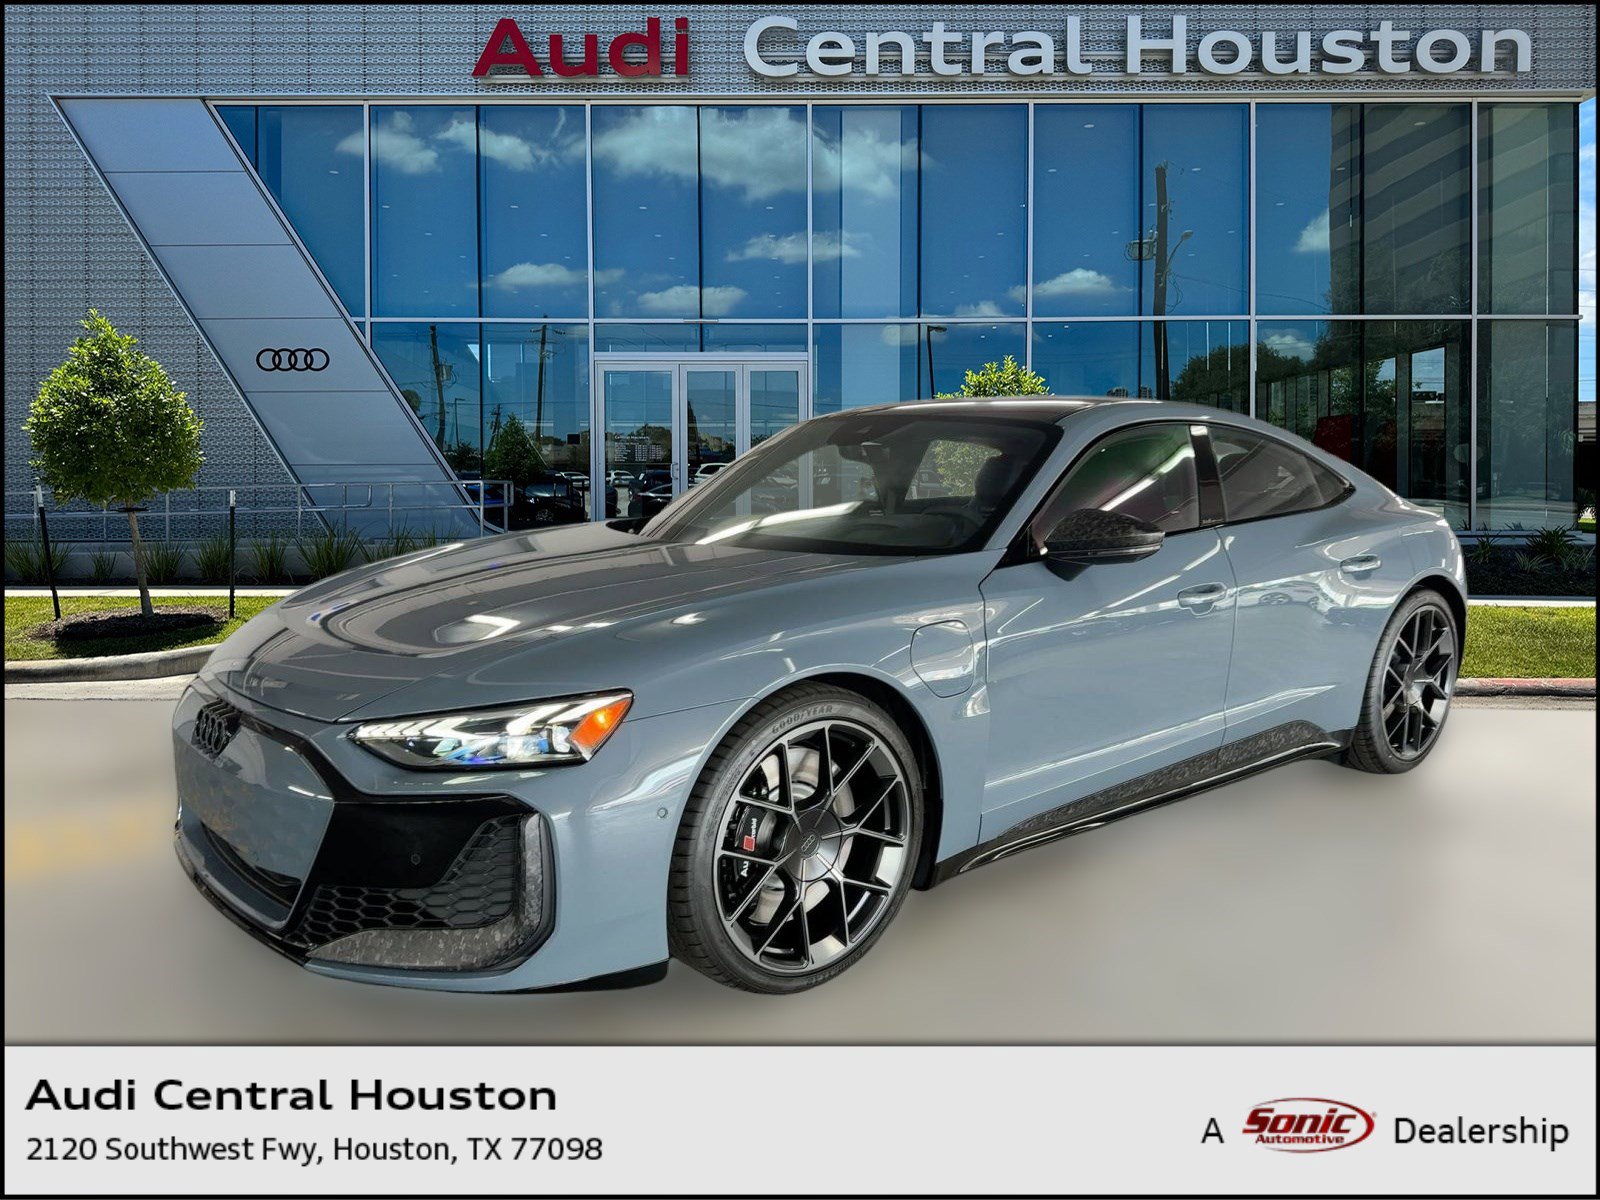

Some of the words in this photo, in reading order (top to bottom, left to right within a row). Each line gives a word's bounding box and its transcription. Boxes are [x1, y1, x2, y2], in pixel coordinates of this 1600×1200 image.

[472, 17, 689, 78] Audi
[743, 15, 1092, 78] Central
[1126, 15, 1532, 76] Houston
